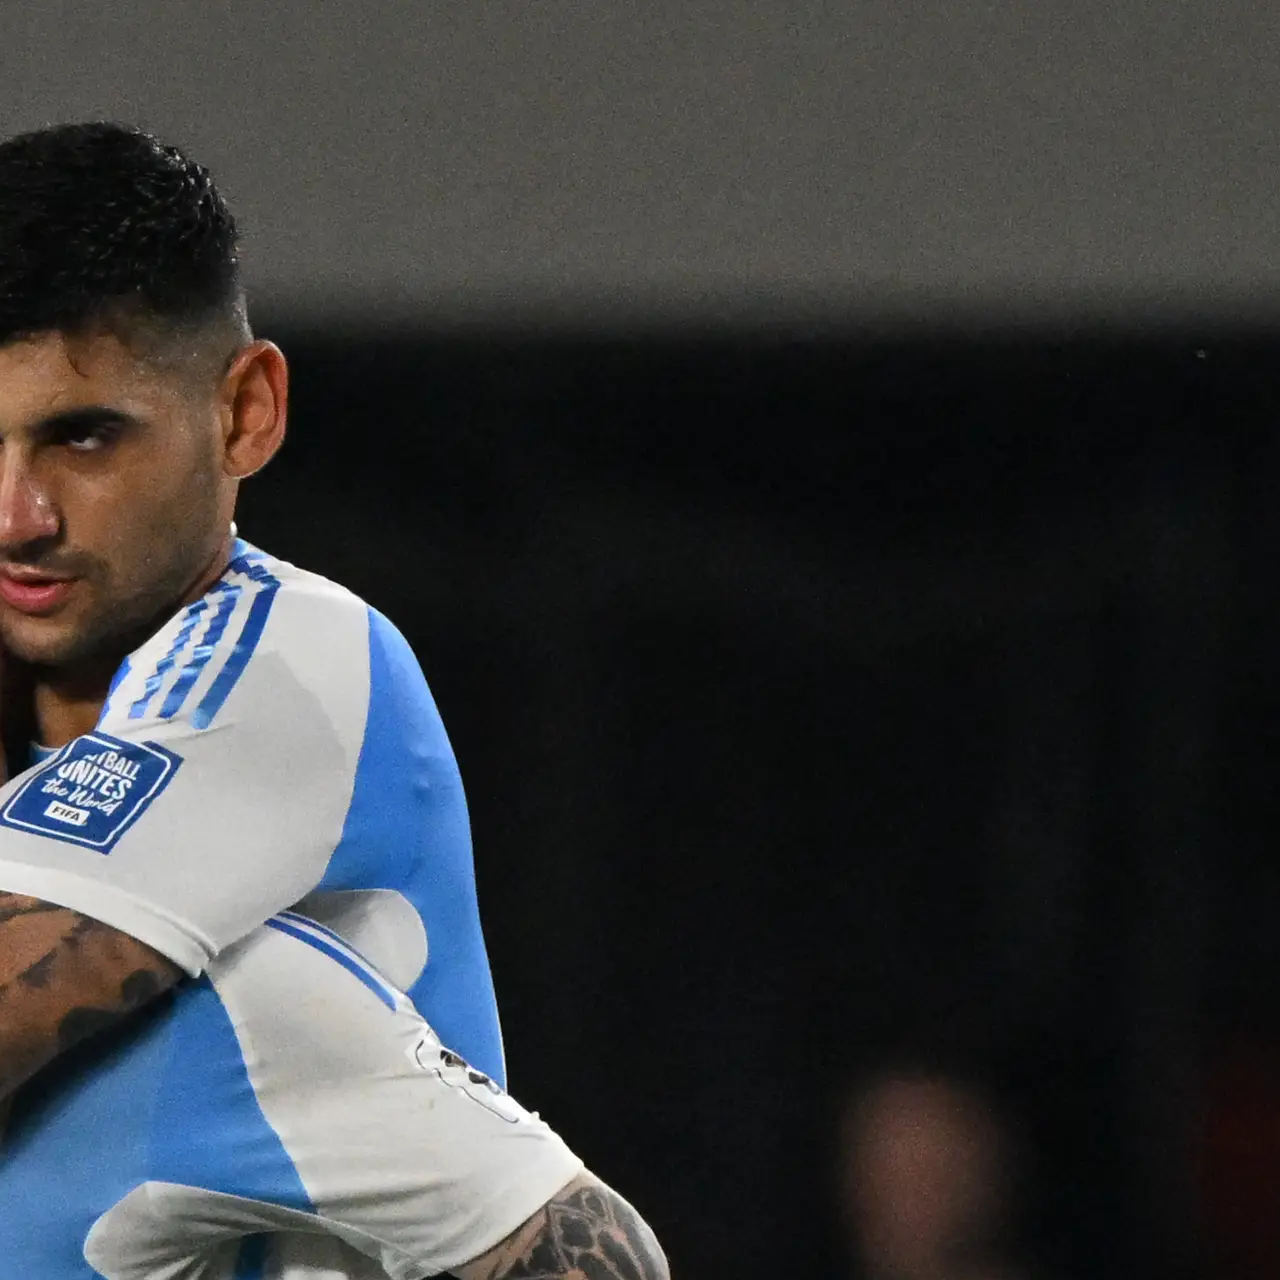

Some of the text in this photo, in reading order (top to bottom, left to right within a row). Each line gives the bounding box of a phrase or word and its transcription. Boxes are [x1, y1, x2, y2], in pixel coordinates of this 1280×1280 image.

[41, 778, 123, 816] the World
[57, 759, 132, 800] UNITES
[51, 805, 81, 821] FIFA
